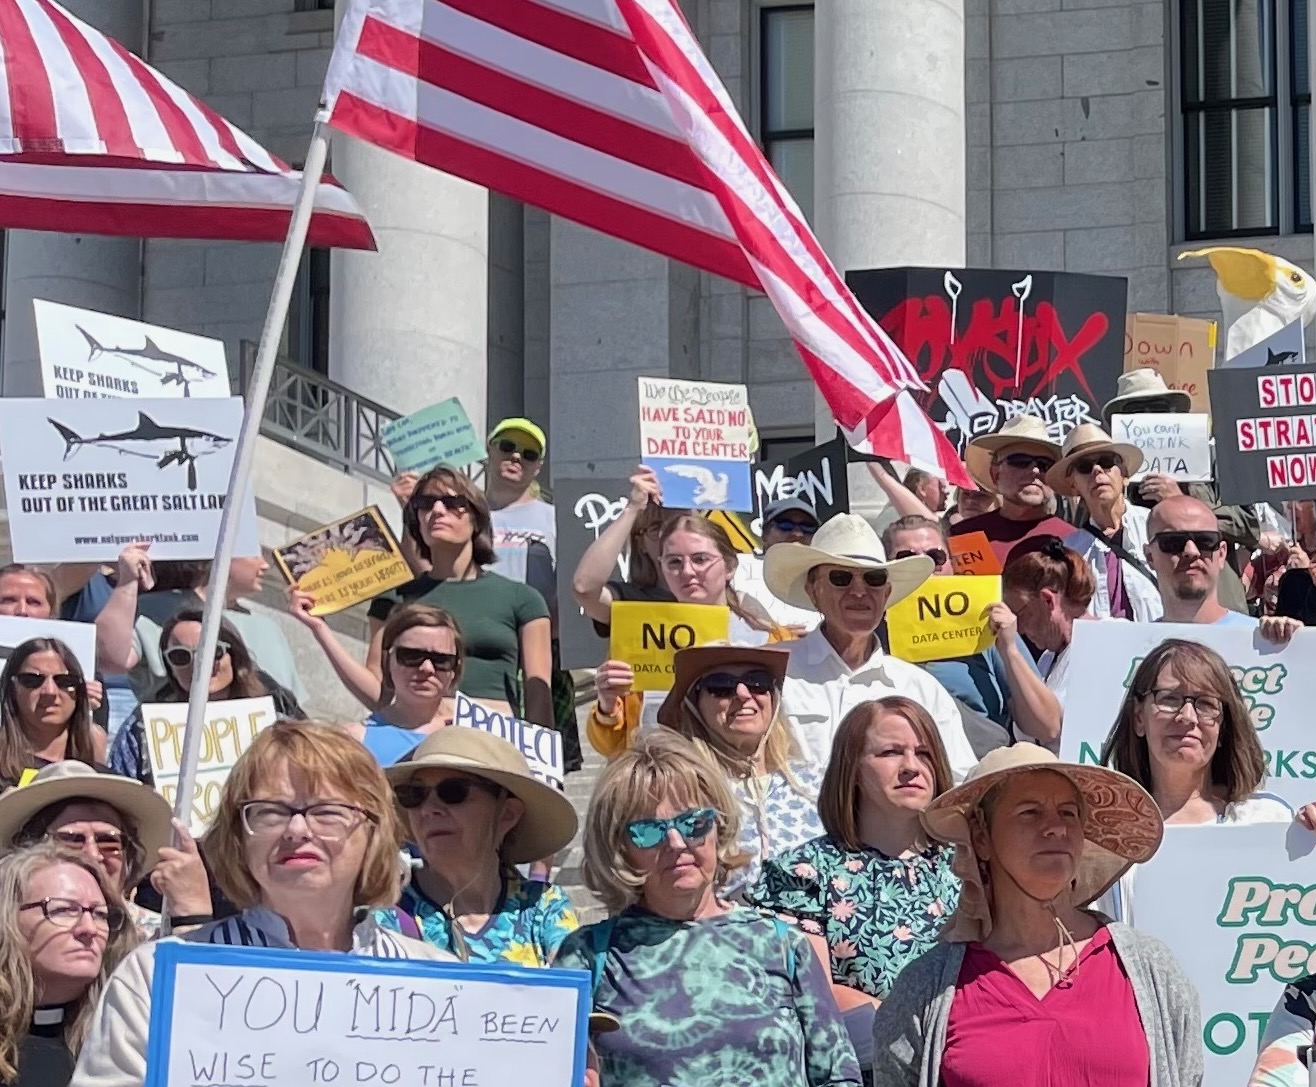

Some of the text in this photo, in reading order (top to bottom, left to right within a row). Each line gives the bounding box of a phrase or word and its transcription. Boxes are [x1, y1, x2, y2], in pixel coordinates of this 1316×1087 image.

[53, 364, 140, 395] KEEP SHARKS
[56, 385, 80, 399] OUT
[643, 381, 666, 400] We
[690, 386, 741, 407] People
[642, 406, 725, 426] HAVE SAID
[672, 425, 724, 441] TO YOUR
[1120, 419, 1151, 440] You
[647, 437, 748, 458] DATA CENTER
[1133, 437, 1191, 450] DRINK
[18, 472, 128, 490] KEEP SHARKS
[22, 494, 198, 514] OUT OF THE GREAT SALT
[917, 591, 970, 622] NO
[642, 623, 695, 651] NO
[912, 626, 983, 645] DATA CENTER
[633, 664, 662, 674] DATA
[205, 972, 325, 1034] YOU
[480, 1011, 560, 1036] BEEN
[188, 1049, 479, 1087] WISE TO DO THE
